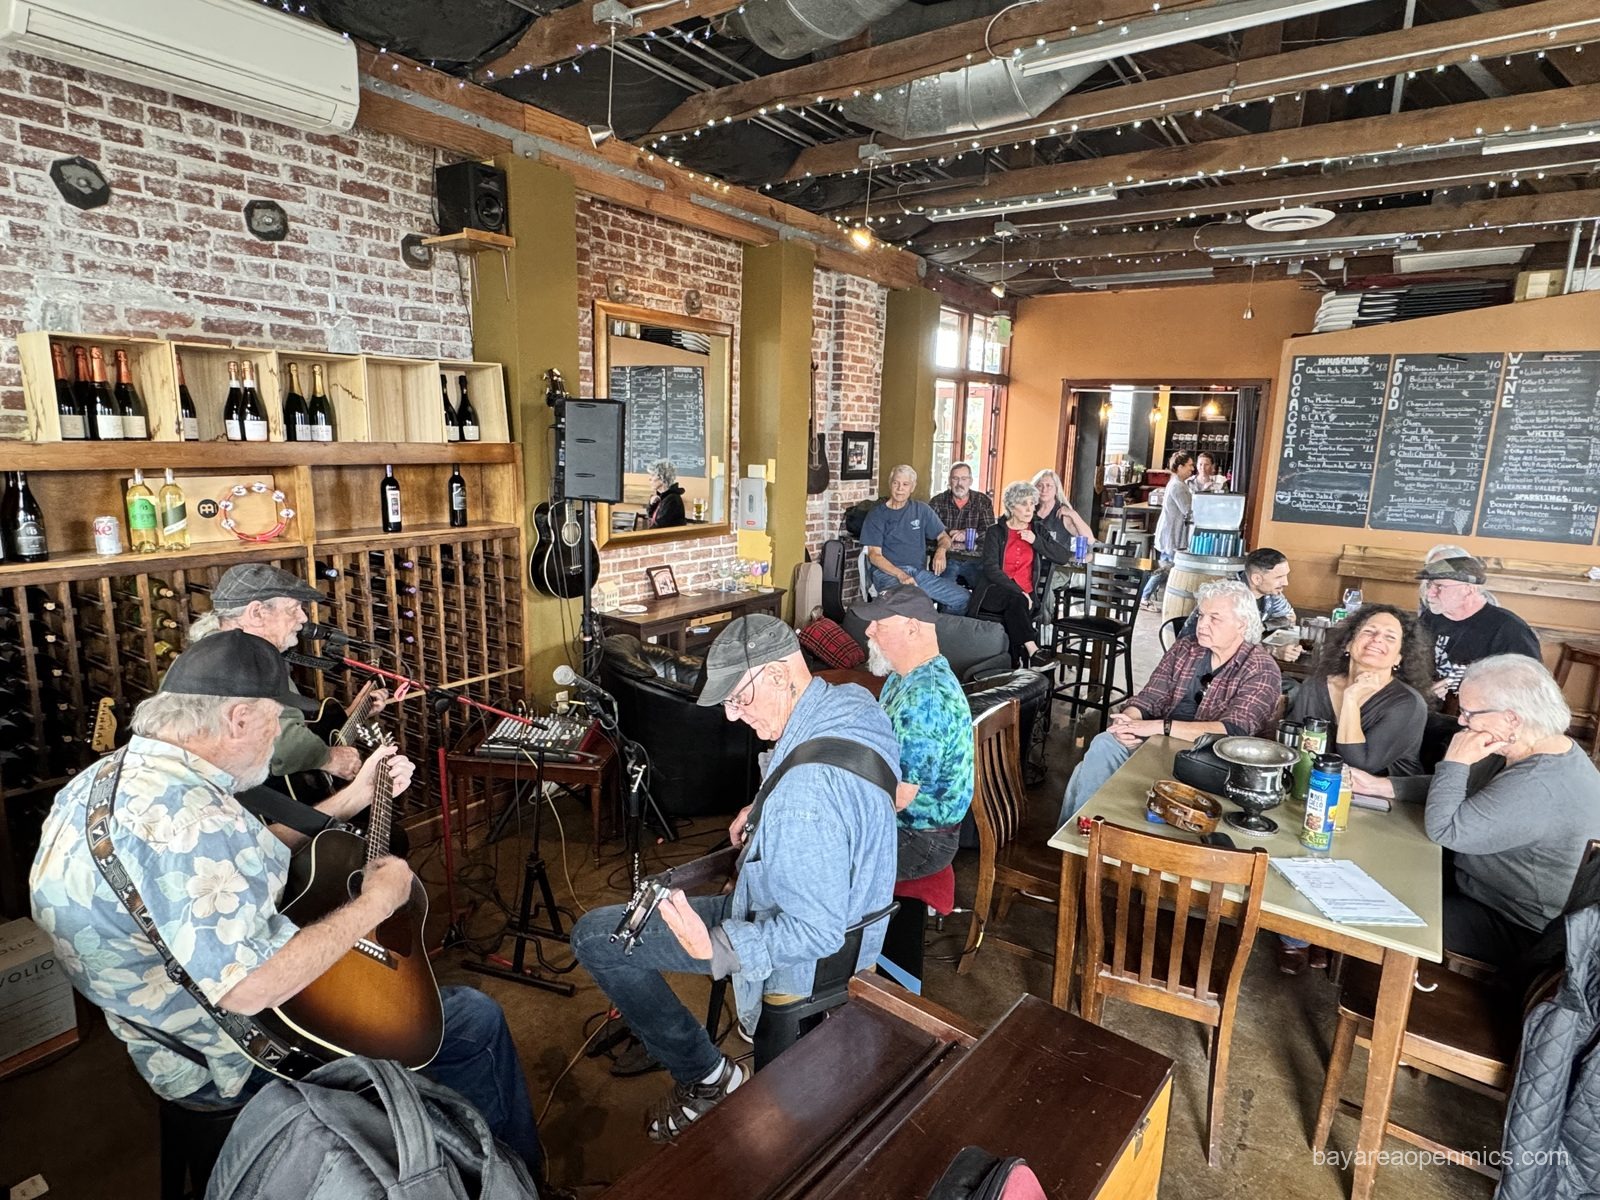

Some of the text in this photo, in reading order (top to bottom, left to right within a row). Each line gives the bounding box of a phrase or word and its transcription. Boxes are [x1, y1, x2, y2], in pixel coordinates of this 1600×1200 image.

[1318, 357, 1370, 366] HOUSEMADE
[1342, 366, 1359, 374] Bomb
[1388, 358, 1406, 411] FOOD
[1501, 352, 1523, 408] WINE
[1284, 357, 1306, 458] FOCACCIA
[1319, 501, 1336, 509] Salad
